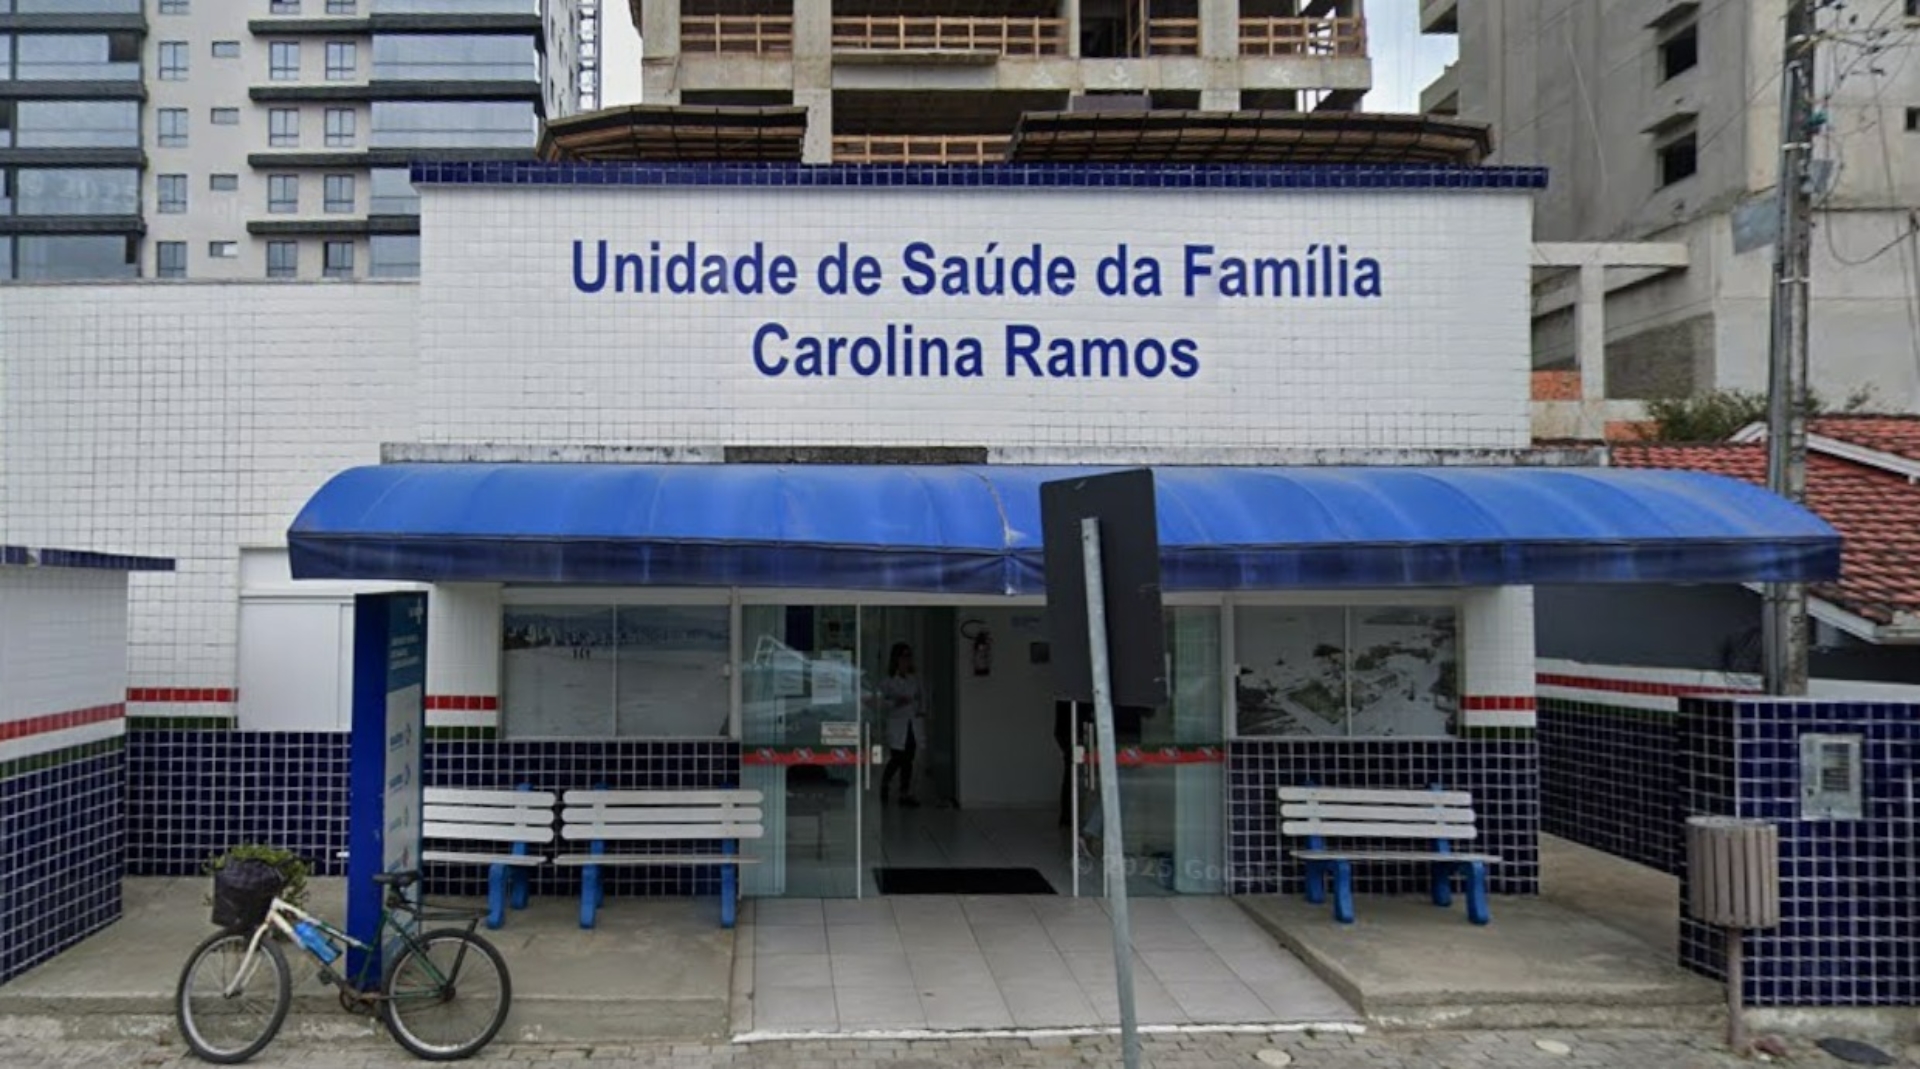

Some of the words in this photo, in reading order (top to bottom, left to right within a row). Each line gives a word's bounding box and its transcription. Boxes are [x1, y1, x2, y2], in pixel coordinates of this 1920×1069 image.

[573, 240, 797, 295] Unidade
[817, 243, 881, 296] de
[902, 241, 1076, 296] Saúde
[1096, 243, 1161, 297] da
[1184, 243, 1381, 297] Família
[753, 323, 983, 377] Carolina
[1005, 324, 1199, 378] Ramos
